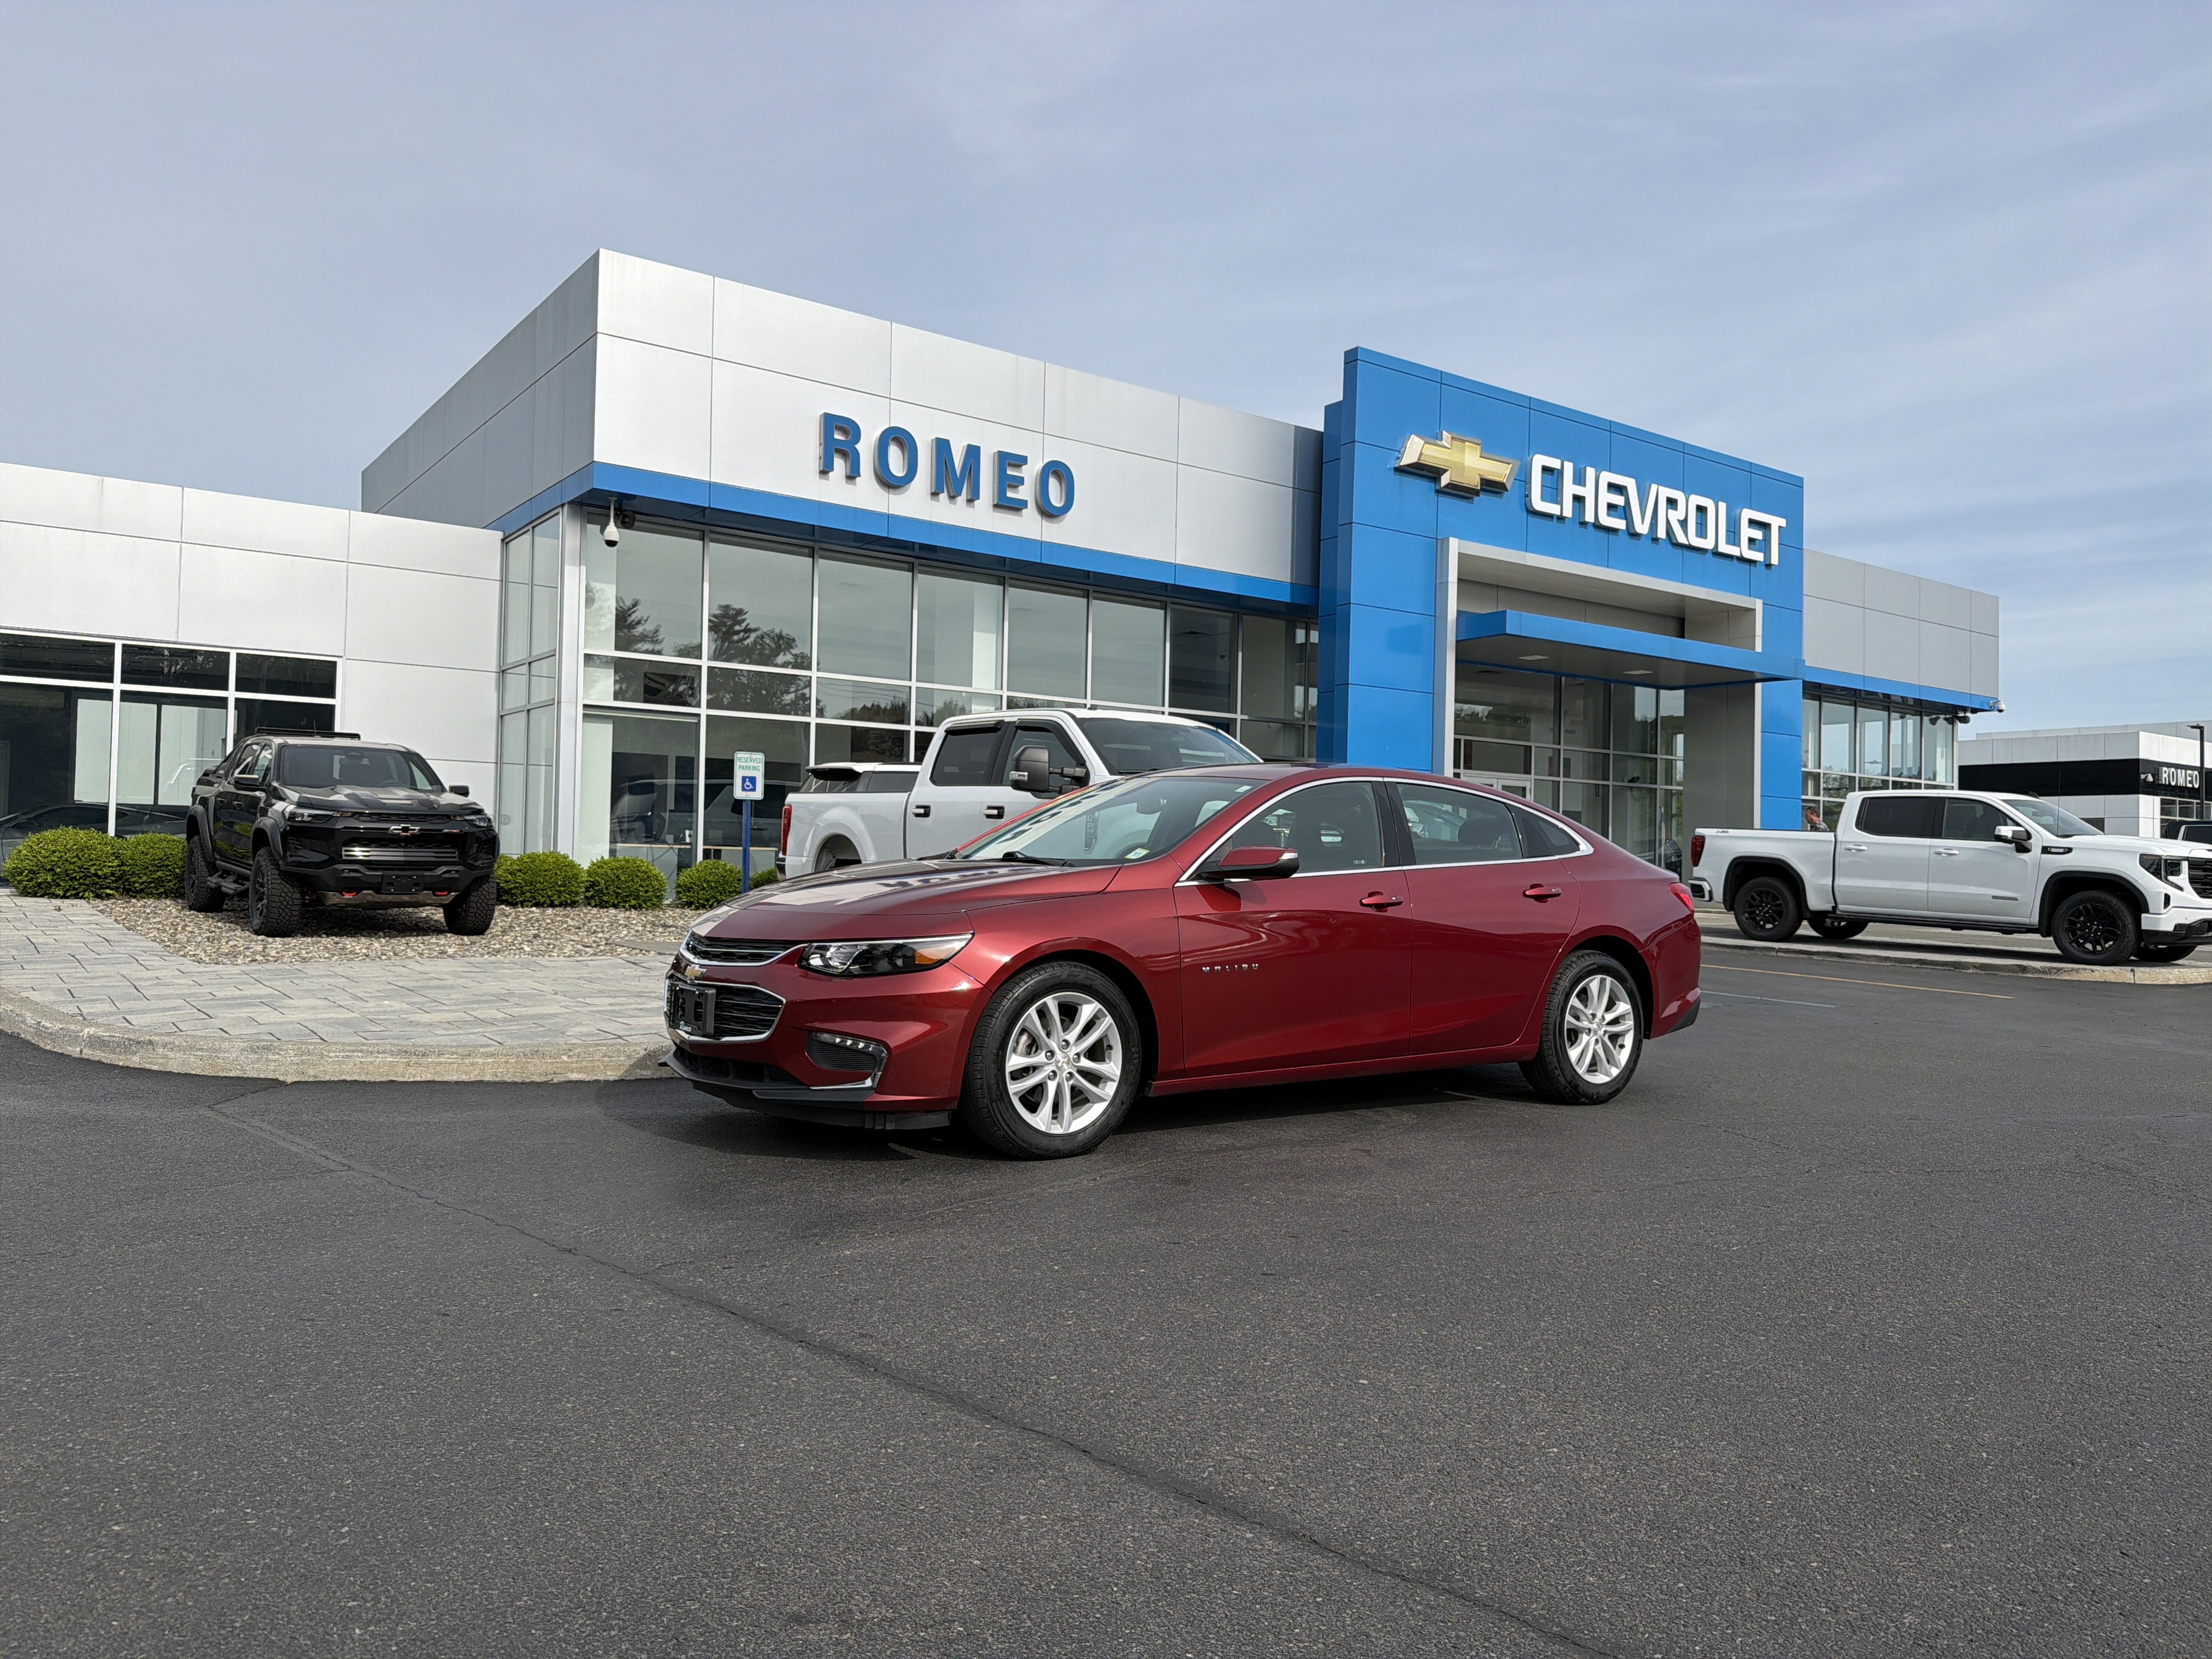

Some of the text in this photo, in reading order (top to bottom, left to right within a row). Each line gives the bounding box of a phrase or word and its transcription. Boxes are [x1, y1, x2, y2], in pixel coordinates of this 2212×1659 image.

[819, 412, 1075, 517] ROMEO
[1526, 454, 1786, 566] CHEVROLET
[2162, 767, 2199, 788] ROMEO
[1202, 963, 1259, 973] MALIBU
